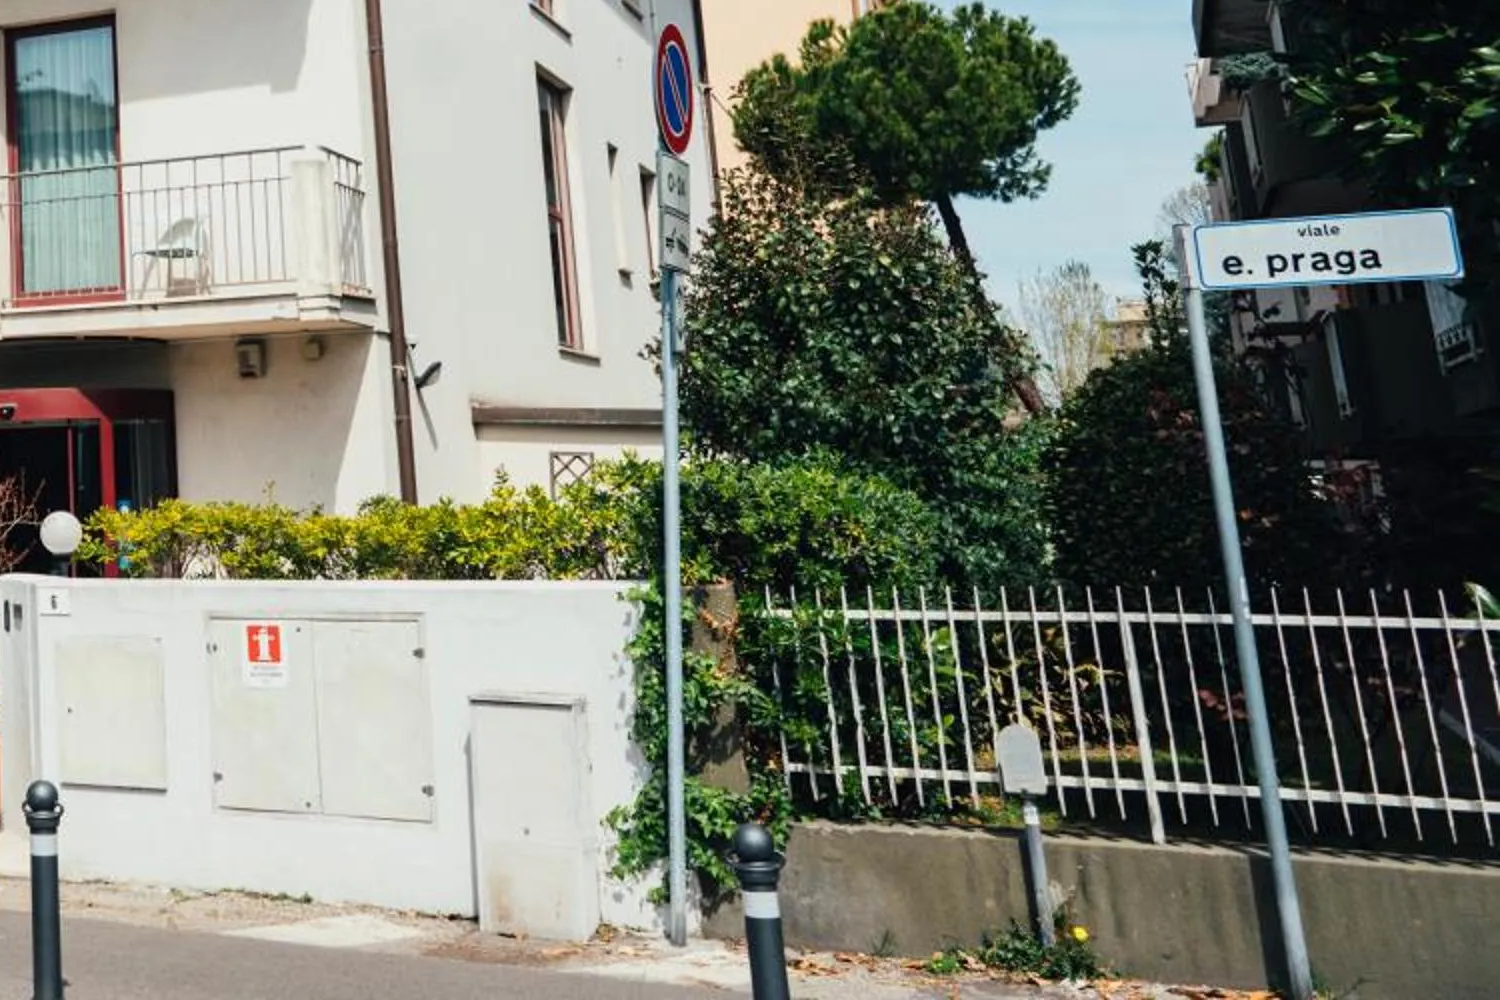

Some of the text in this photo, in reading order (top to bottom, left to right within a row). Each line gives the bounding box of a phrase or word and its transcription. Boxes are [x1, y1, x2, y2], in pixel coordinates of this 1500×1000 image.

[1296, 223, 1341, 238] viale
[1222, 248, 1382, 277] e. praga
